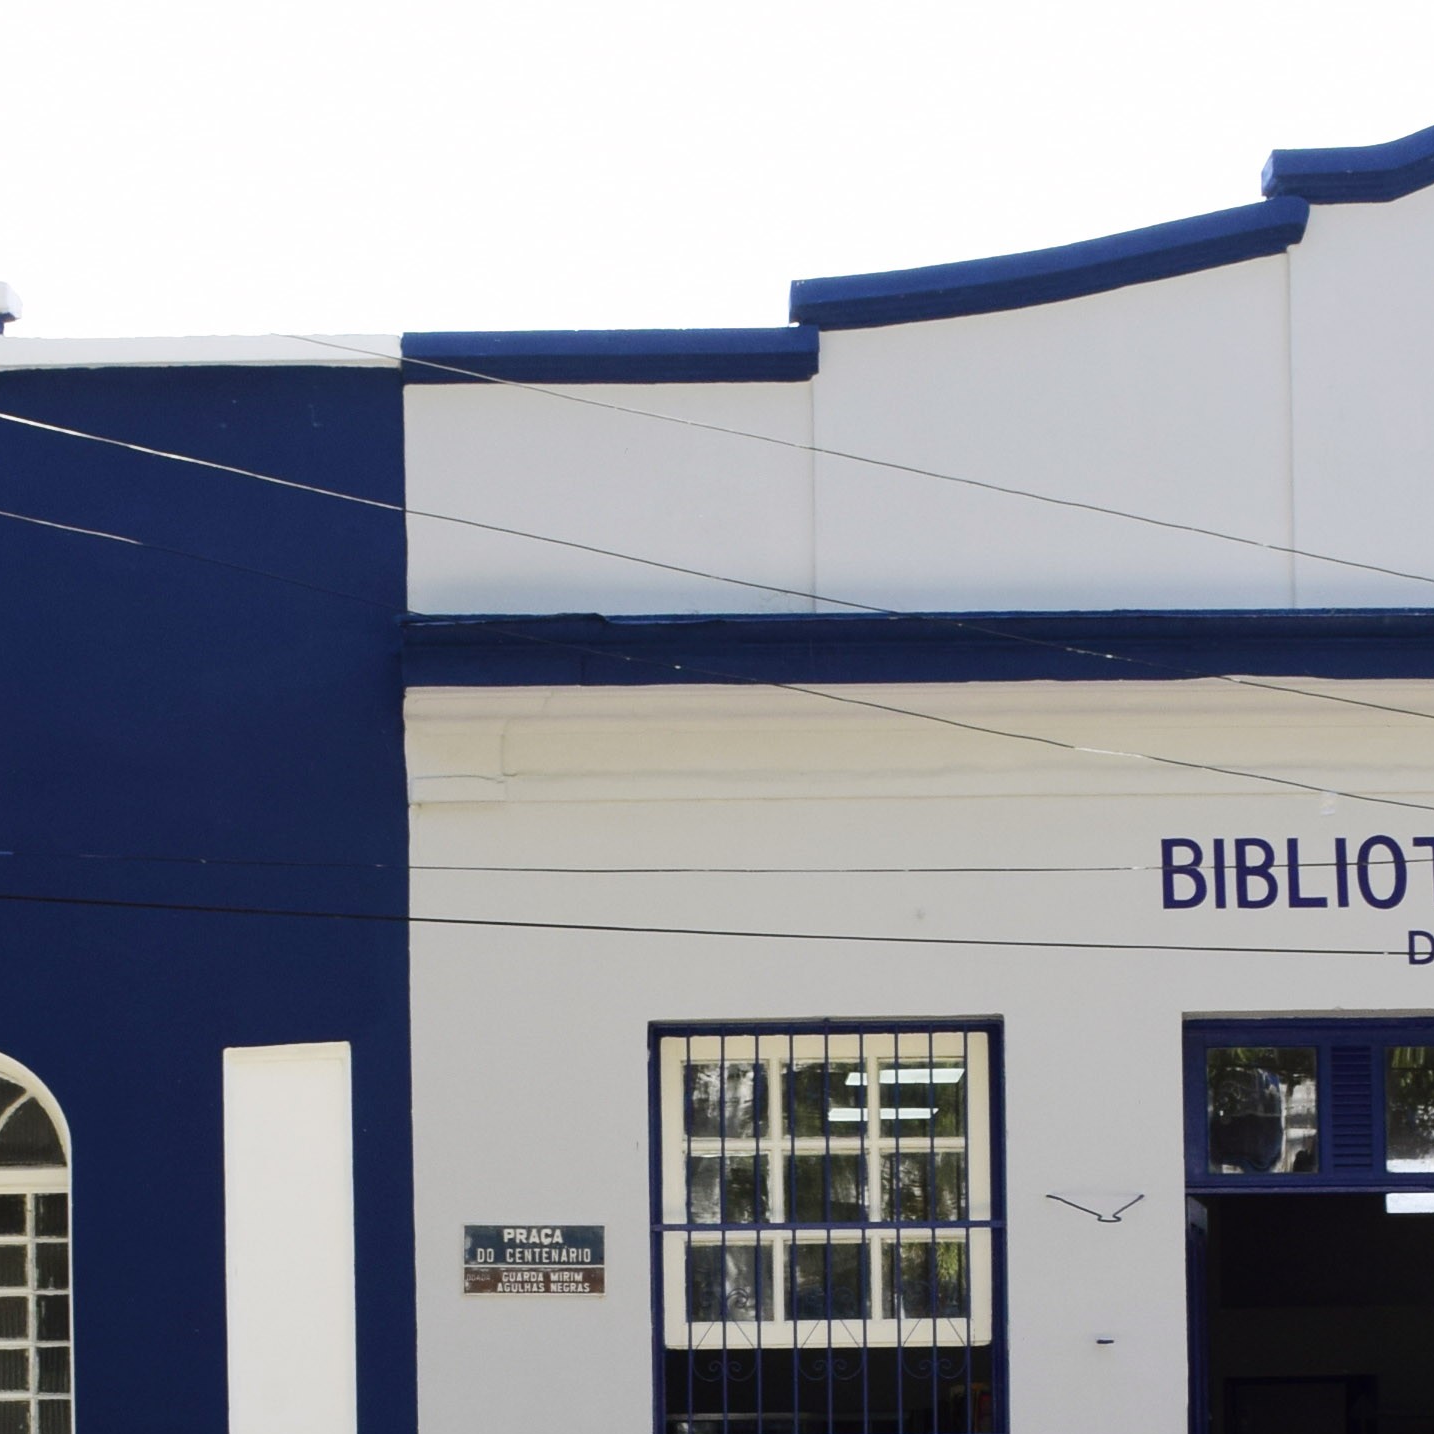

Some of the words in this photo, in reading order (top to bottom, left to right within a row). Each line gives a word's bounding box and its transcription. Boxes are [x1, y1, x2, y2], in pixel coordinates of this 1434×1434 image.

[503, 1228, 563, 1245] PRAÇA
[477, 1248, 494, 1263] DO
[502, 1272, 544, 1282] GUARDA
[550, 1272, 583, 1282] MIRIM
[497, 1282, 544, 1292] AGULHAS
[550, 1282, 590, 1292] NEGRAS
